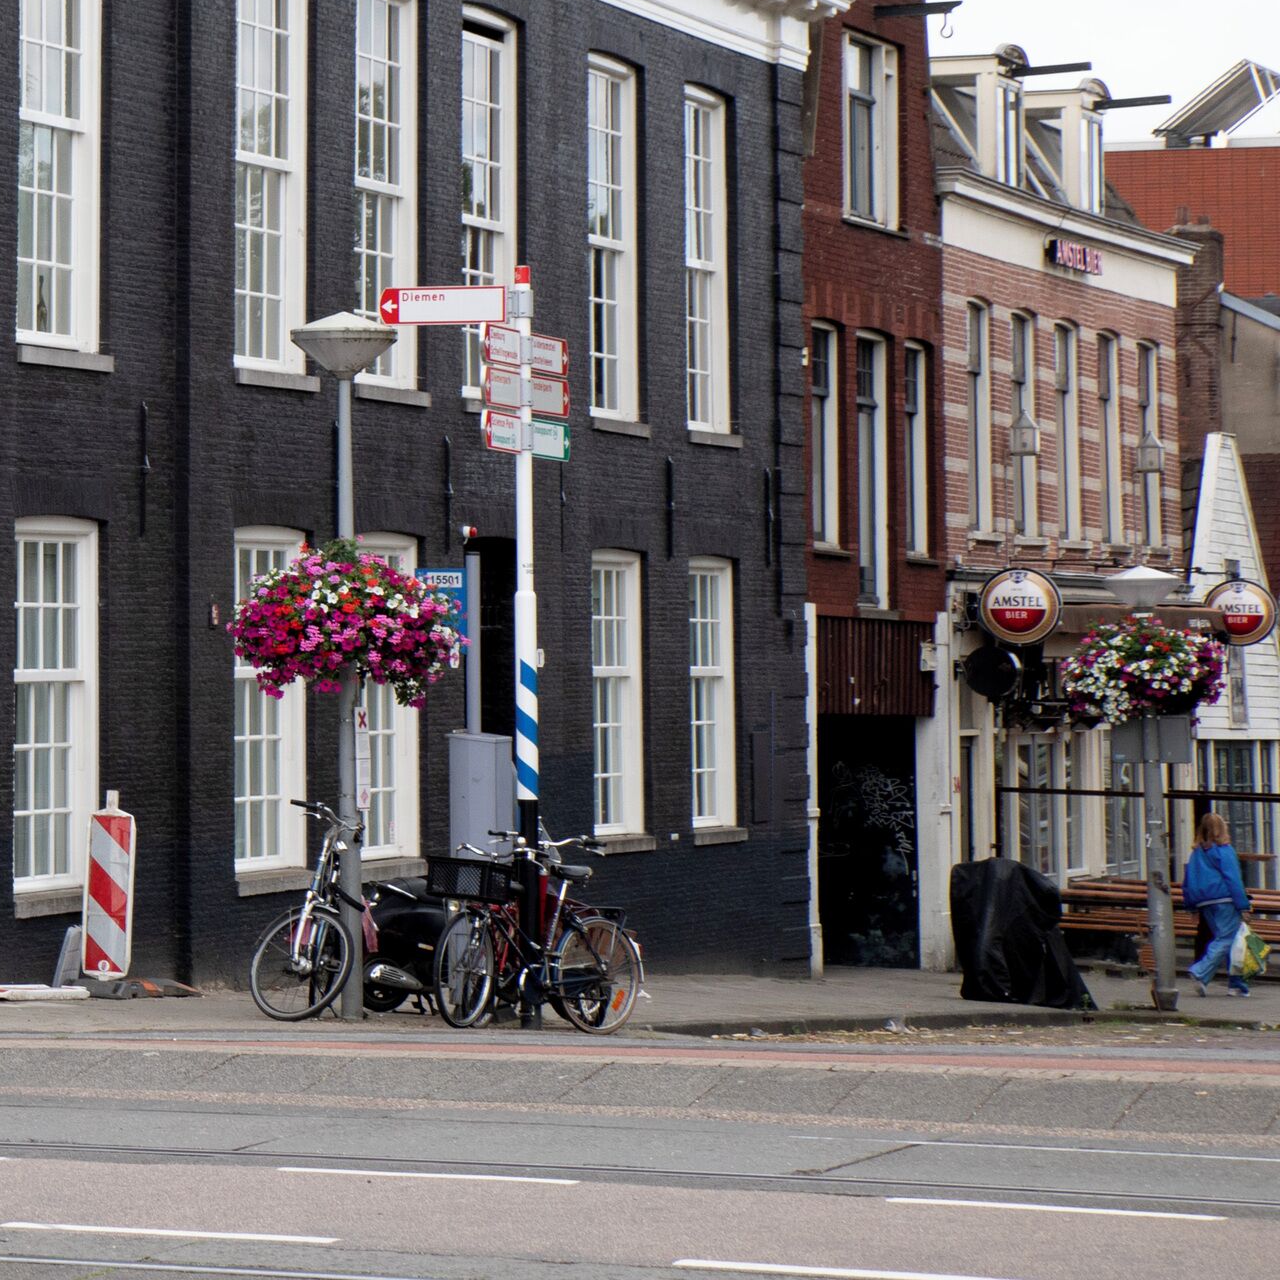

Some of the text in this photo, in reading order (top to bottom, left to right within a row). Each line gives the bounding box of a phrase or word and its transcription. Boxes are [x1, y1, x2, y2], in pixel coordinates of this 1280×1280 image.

[1056, 239, 1086, 270] AMSTEL
[401, 292, 446, 302] Diemen
[431, 575, 460, 585] 15501
[992, 596, 1042, 607] AMSTEL
[1217, 604, 1261, 614] AMSTEL
[1005, 611, 1028, 619] BIER
[1227, 616, 1248, 624] BIER
